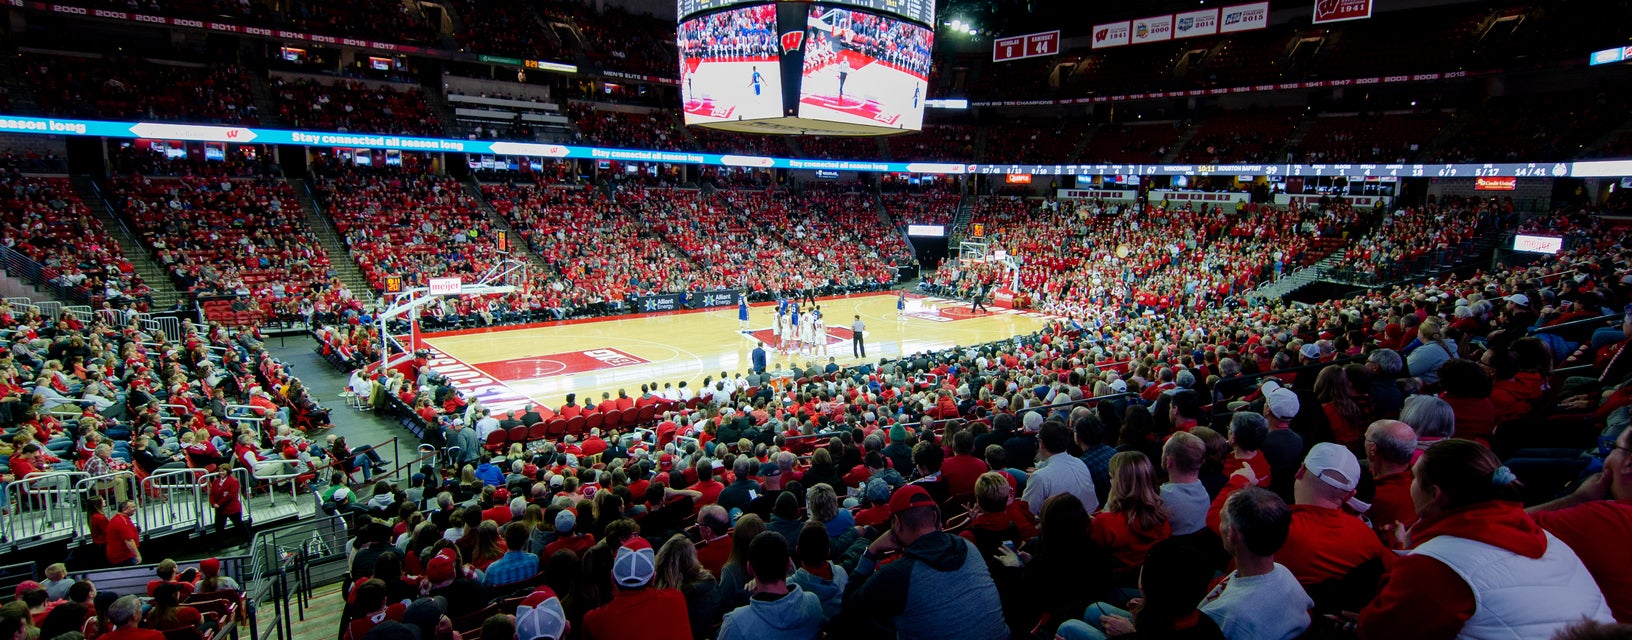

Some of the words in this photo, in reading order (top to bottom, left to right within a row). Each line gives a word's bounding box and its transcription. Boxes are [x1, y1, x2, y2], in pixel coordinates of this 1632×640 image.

[1340, 4, 1364, 12] 1941
[53, 4, 87, 14] 2000
[95, 9, 127, 19] 2003
[135, 14, 166, 24] 2005
[174, 18, 203, 28] 2008
[211, 22, 236, 31] 2011
[246, 27, 272, 36] 2012
[279, 31, 305, 39] 2014
[311, 34, 335, 43] 2015
[343, 37, 366, 46] 2016
[373, 41, 395, 50] 2017
[1035, 40, 1048, 54] 44
[49, 120, 86, 134] long
[292, 132, 320, 144] Stay
[322, 134, 384, 146] connected
[386, 137, 400, 147] all
[402, 140, 438, 148] season
[440, 140, 464, 151] long
[592, 148, 610, 158] Stay
[611, 150, 651, 159] connected
[688, 154, 704, 162] long
[1146, 166, 1157, 174] 67
[1266, 166, 1278, 174] 39
[1524, 238, 1550, 250] meijer
[432, 281, 458, 292] meijer
